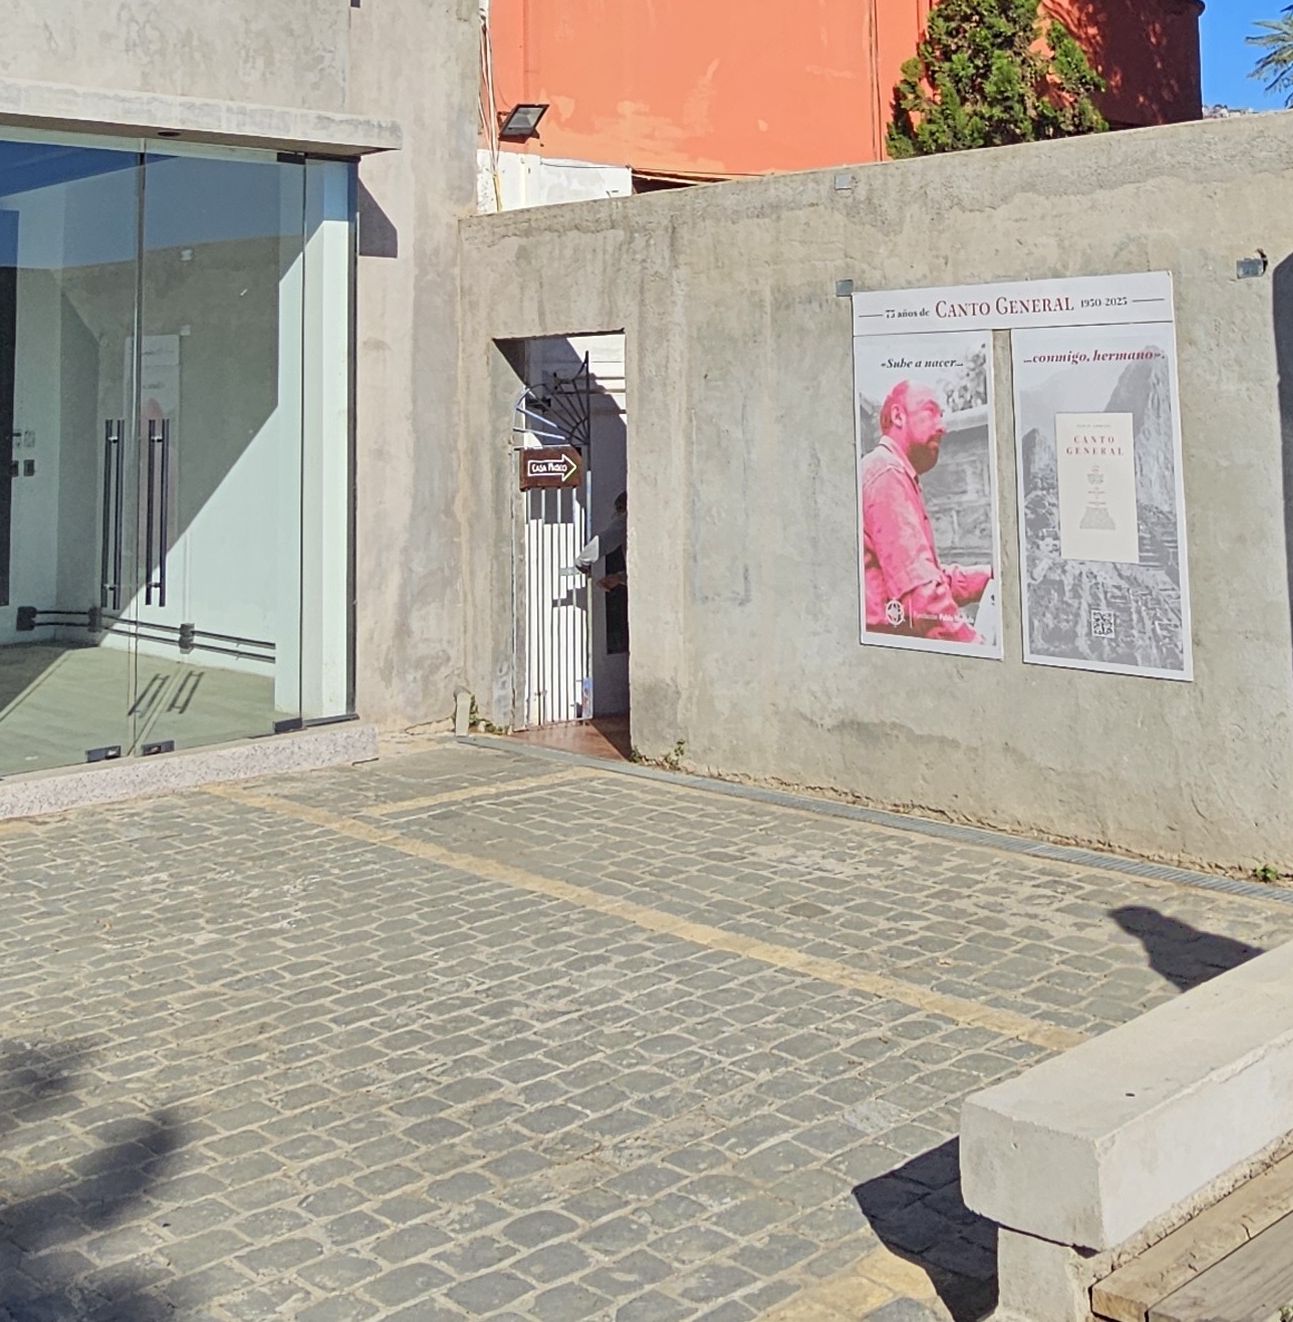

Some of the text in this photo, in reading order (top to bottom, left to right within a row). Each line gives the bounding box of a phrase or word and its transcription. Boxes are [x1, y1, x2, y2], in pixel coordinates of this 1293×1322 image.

[897, 308, 918, 318] años
[919, 307, 930, 317] de
[935, 300, 991, 318] CANTO
[995, 296, 1075, 315] GENERAL
[914, 360, 922, 368] a
[1073, 436, 1115, 444] CANTO
[1066, 447, 1124, 455] GENERAL
[531, 463, 547, 472] CASA
